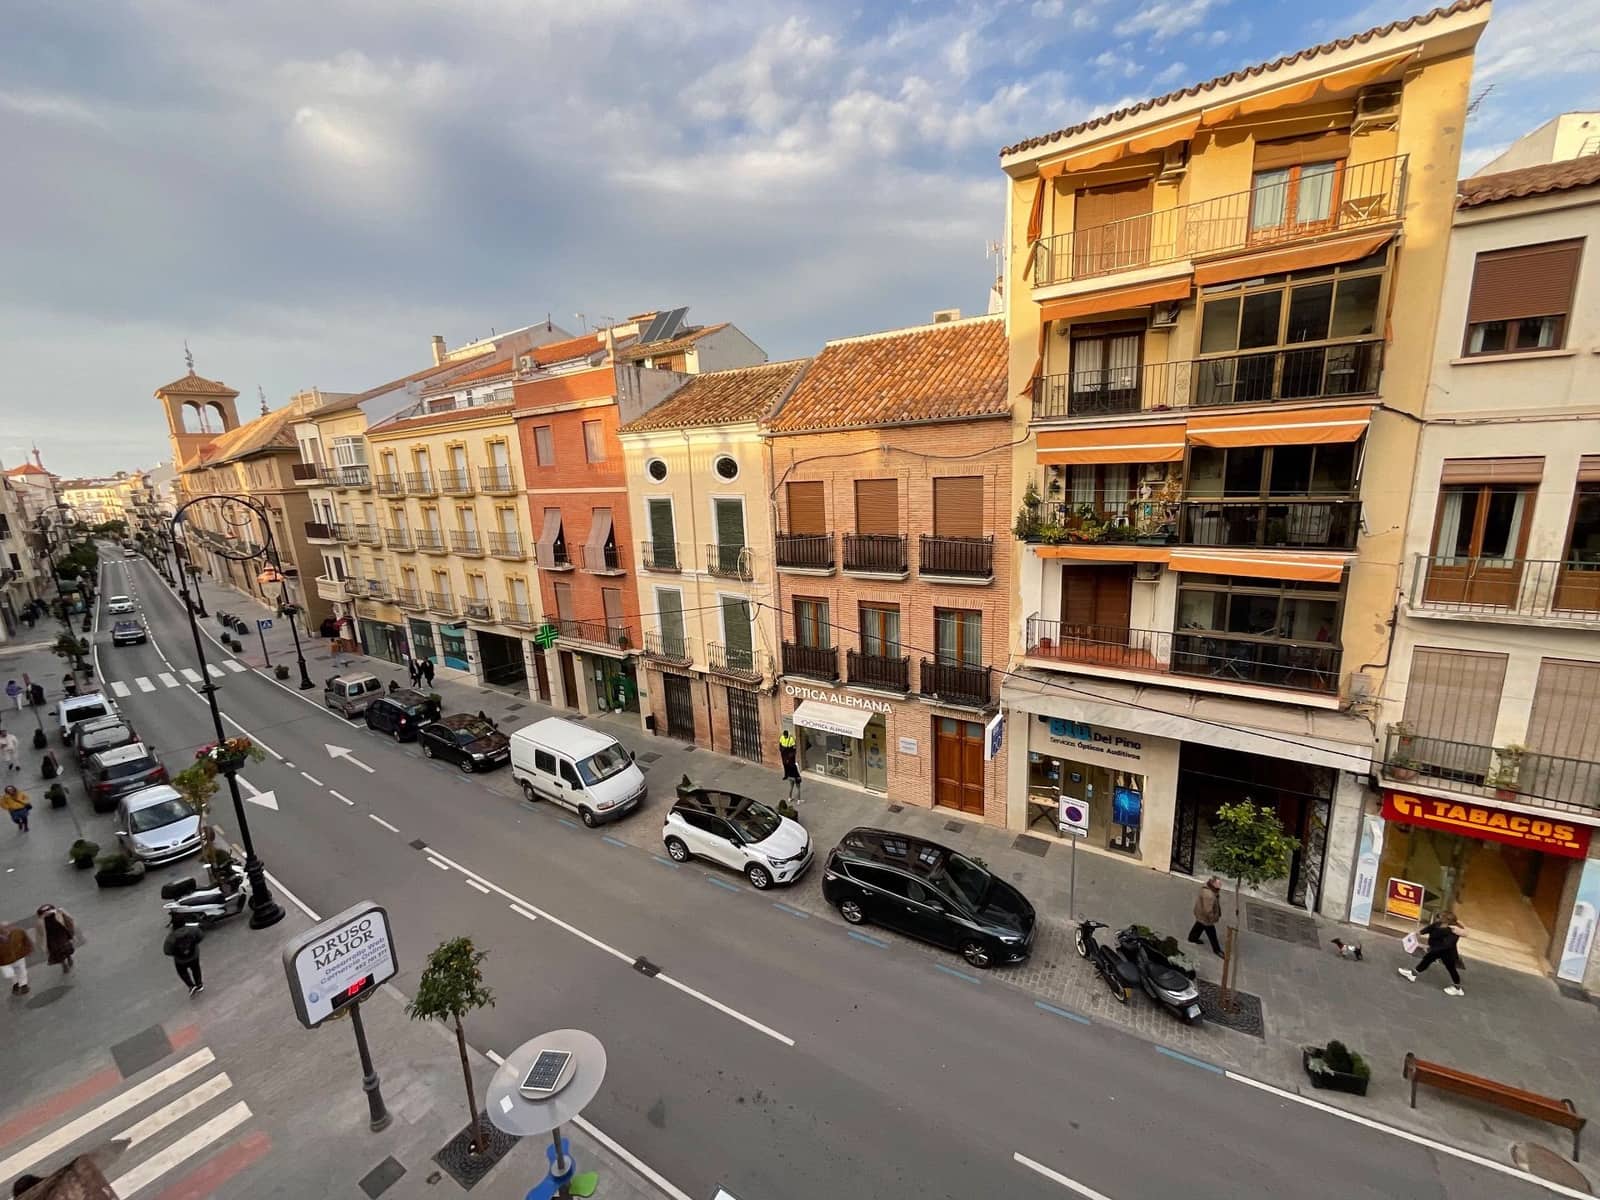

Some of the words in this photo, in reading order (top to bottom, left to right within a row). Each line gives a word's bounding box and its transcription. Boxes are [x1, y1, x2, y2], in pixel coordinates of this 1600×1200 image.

[785, 685, 828, 703] OPTICA
[830, 692, 893, 714] ALEMANA
[1093, 732, 1112, 745] Del
[1115, 736, 1142, 750] Pino
[1433, 802, 1575, 841] TABACOS
[312, 919, 371, 959] DRUSO
[314, 930, 374, 970] MAIOR
